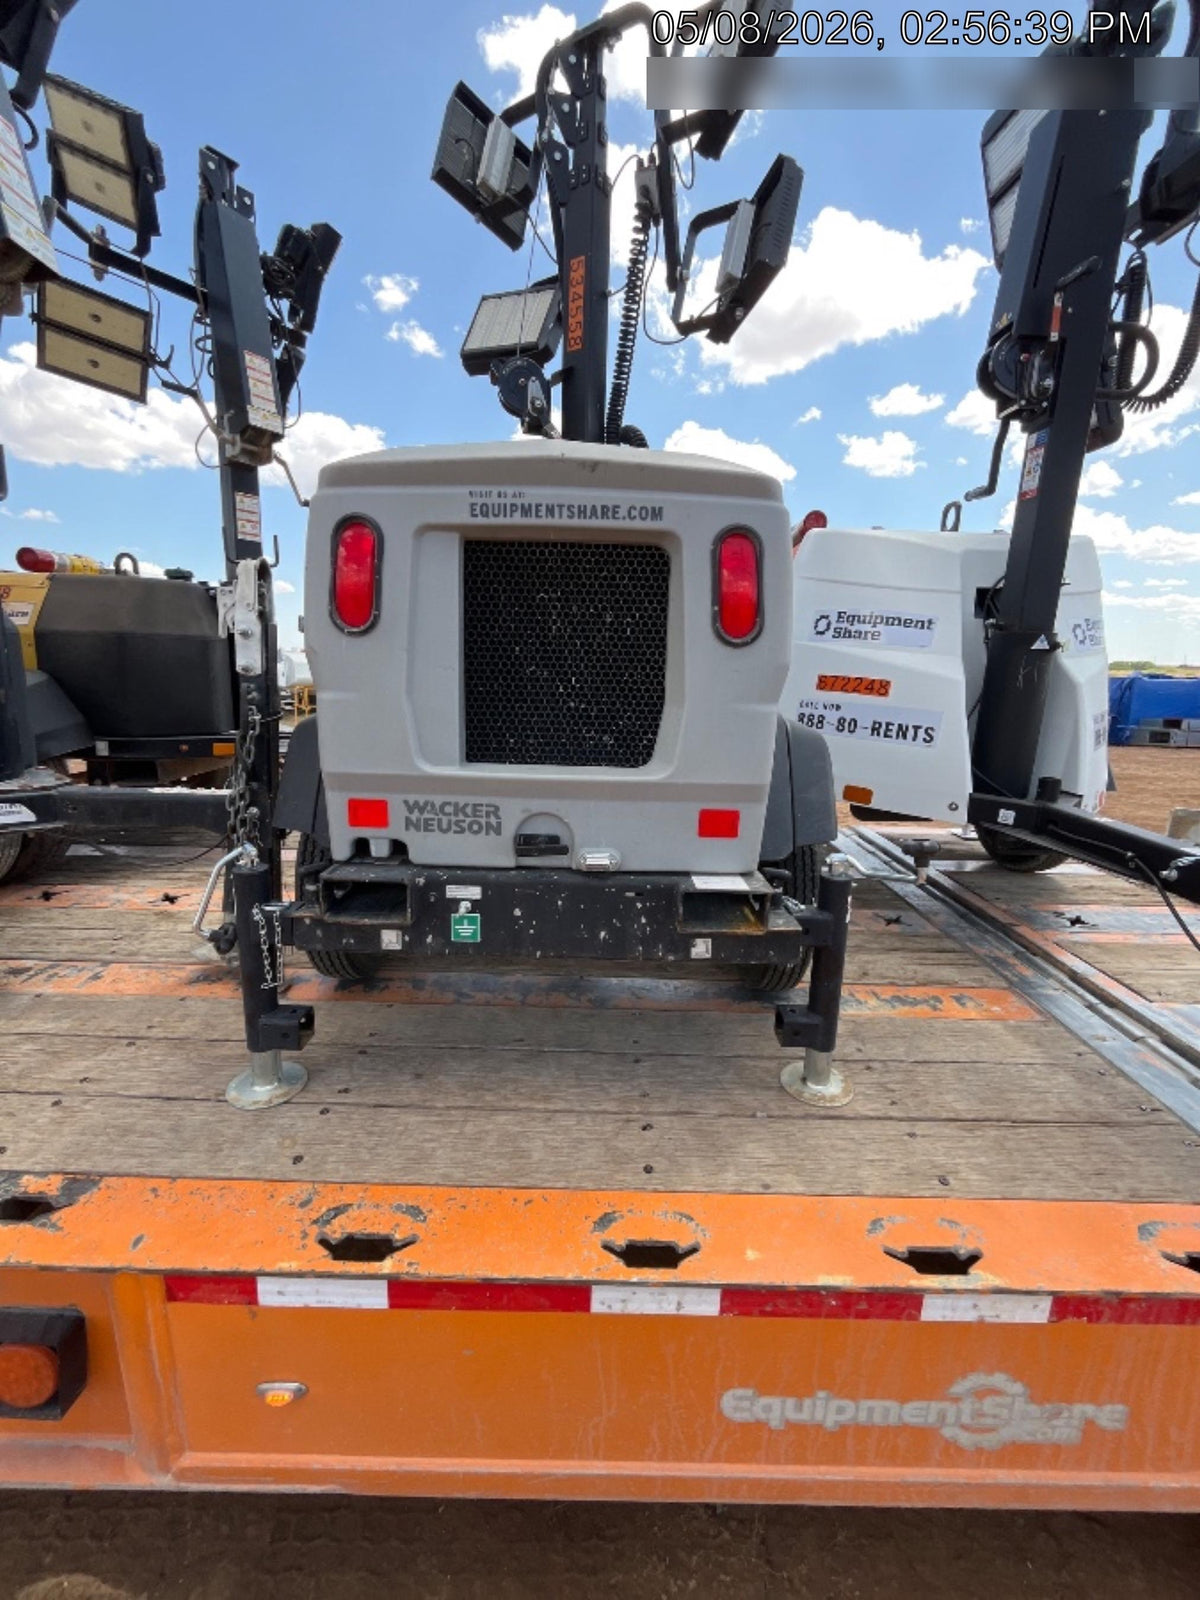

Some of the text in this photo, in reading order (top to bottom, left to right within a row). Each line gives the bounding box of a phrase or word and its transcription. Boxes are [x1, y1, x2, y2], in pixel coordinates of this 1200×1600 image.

[568, 258, 584, 349] 534558
[469, 502, 664, 521] EQUIPMENTSHARE.COM
[835, 611, 937, 631] Equipment
[832, 627, 882, 641] Share
[816, 674, 891, 697] 672248
[402, 799, 502, 820] WACKER
[404, 816, 502, 836] NEUSON
